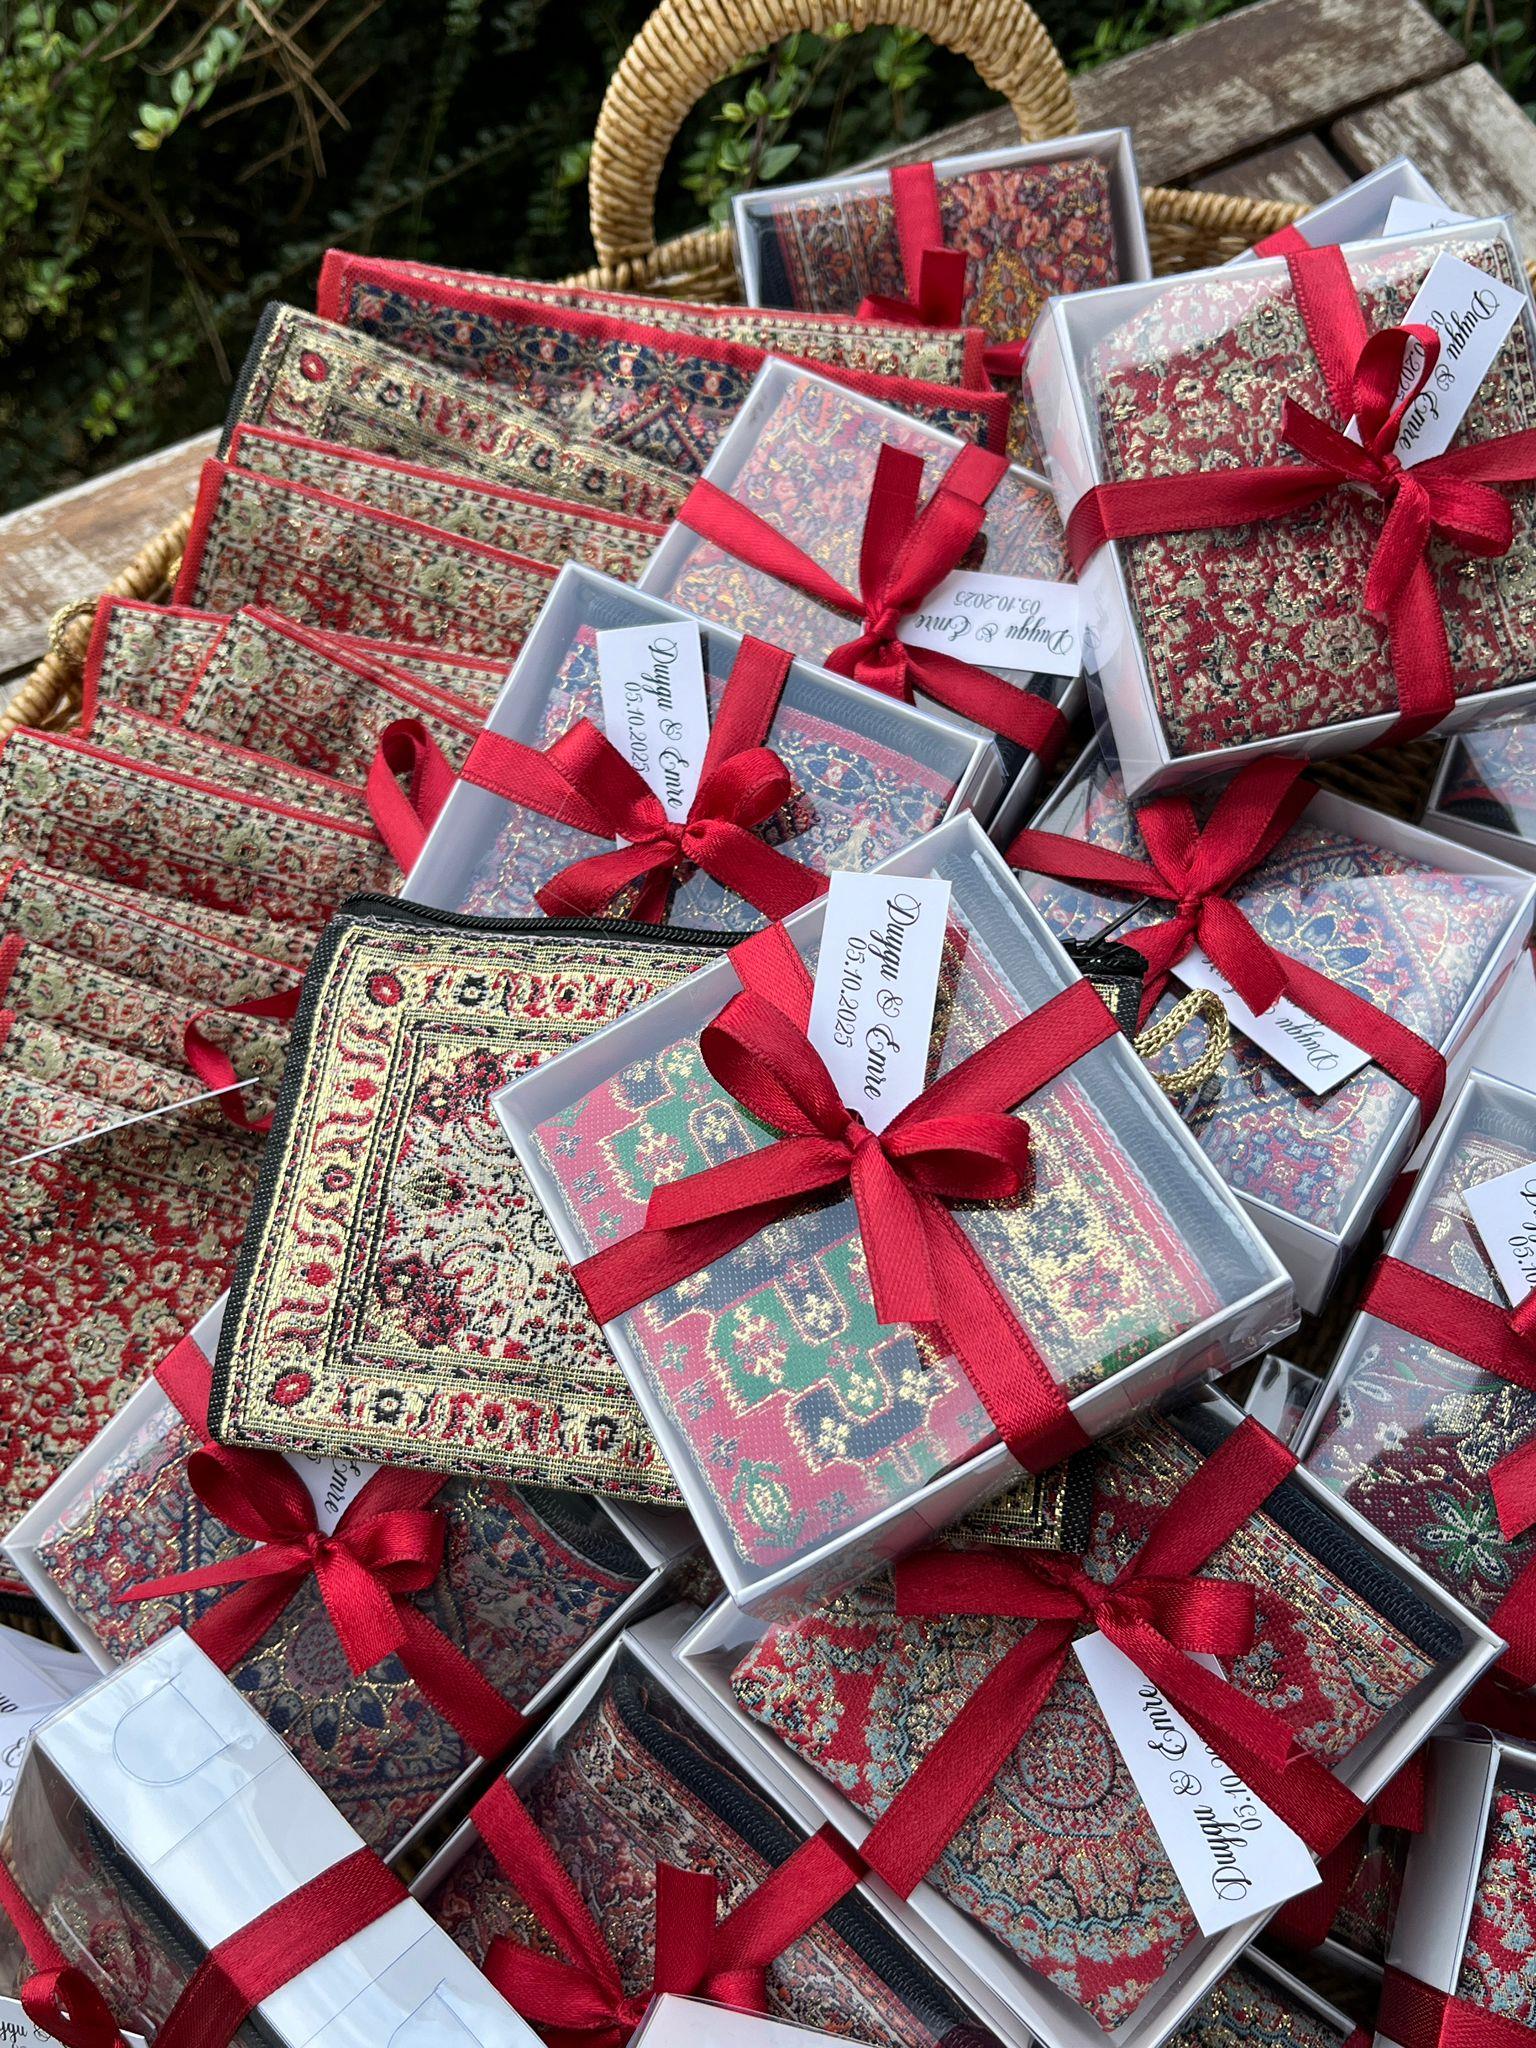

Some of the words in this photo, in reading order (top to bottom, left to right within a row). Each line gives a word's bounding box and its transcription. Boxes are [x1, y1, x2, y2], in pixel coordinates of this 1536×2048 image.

[1444, 289, 1500, 360] Duygu
[1435, 363, 1456, 391] &
[1398, 390, 1439, 450] Emre
[914, 614, 971, 642] Emre
[953, 590, 1041, 615] 05.10.2025
[975, 622, 999, 643] &
[1005, 614, 1074, 655] Duygu
[641, 637, 679, 712] Duygu
[624, 681, 650, 773] 05.10.2025
[658, 718, 683, 741] &
[658, 746, 689, 809] Emre
[867, 893, 922, 982] Duygu
[833, 936, 868, 1049] 05.10.2025
[876, 989, 904, 1018] &
[863, 1023, 901, 1100] Emre
[1275, 1016, 1339, 1072] Duygu
[1138, 1684, 1188, 1761] Emre
[1169, 1769, 1202, 1796] &
[1193, 1804, 1252, 1901] Duygu
